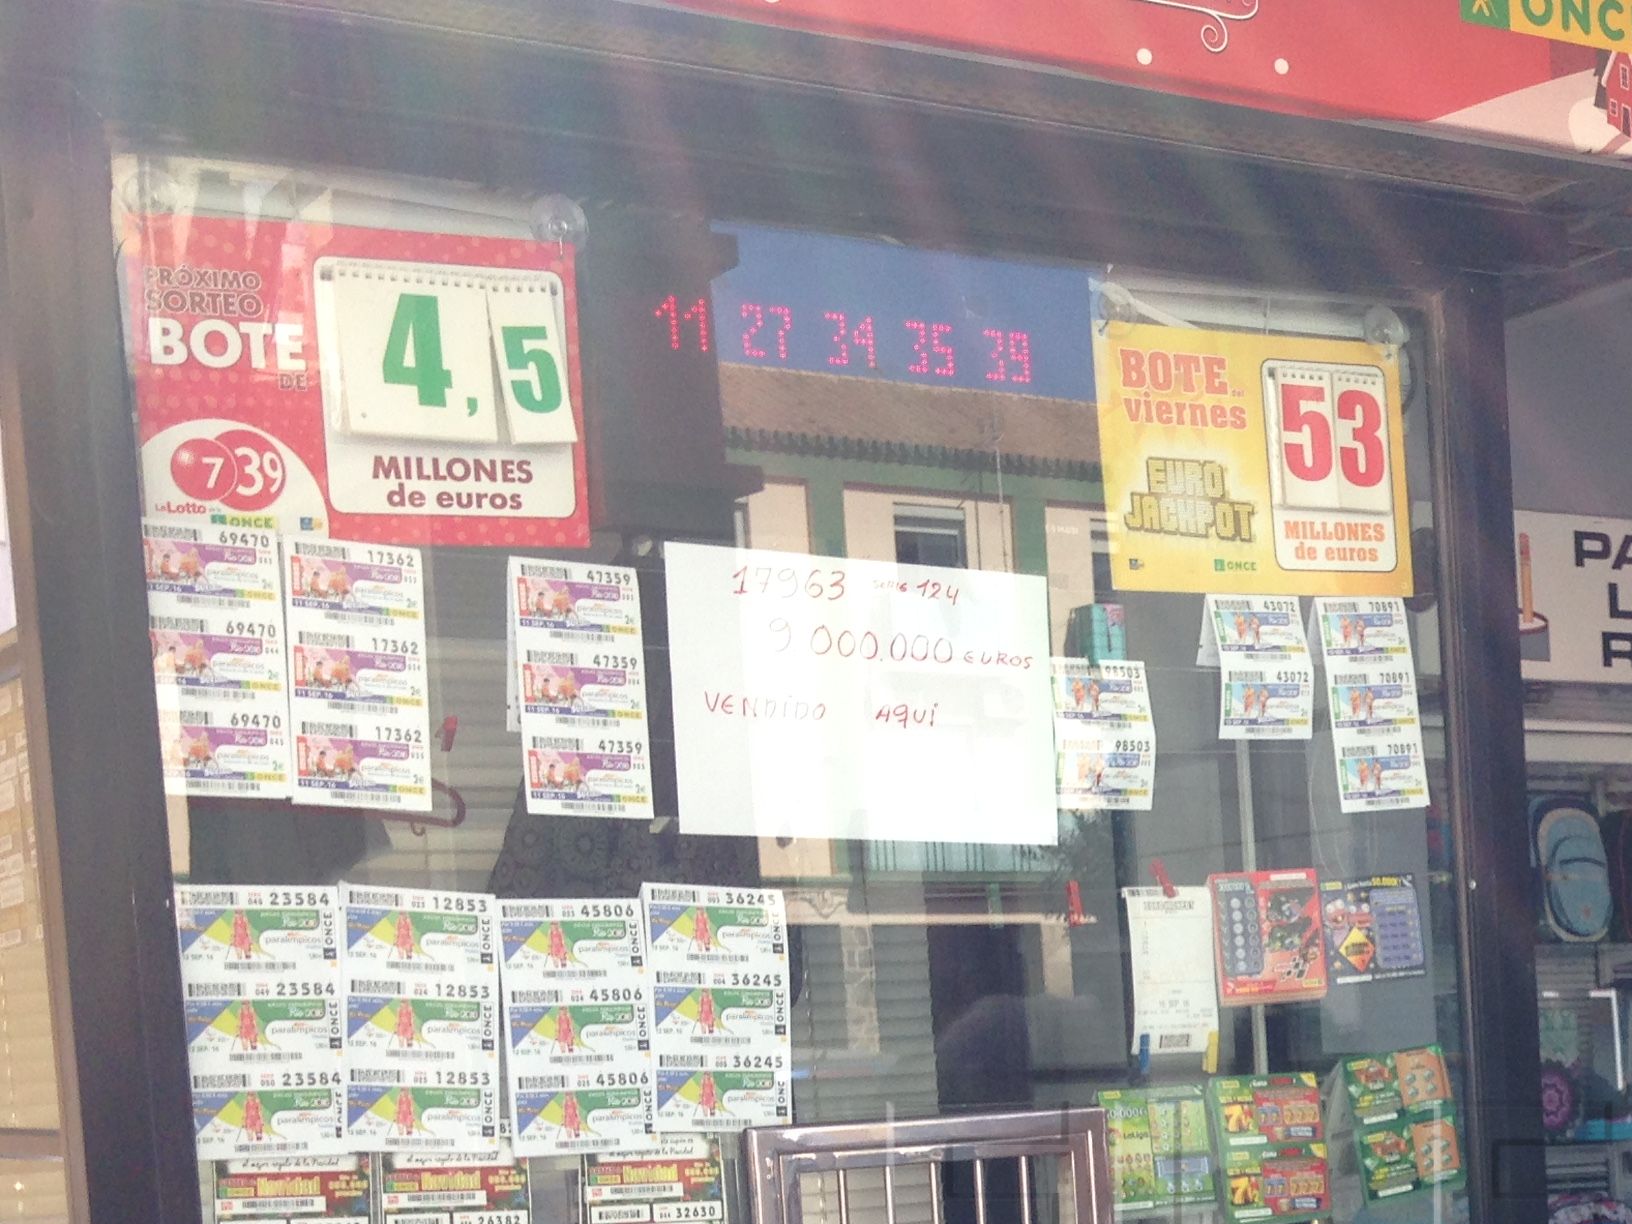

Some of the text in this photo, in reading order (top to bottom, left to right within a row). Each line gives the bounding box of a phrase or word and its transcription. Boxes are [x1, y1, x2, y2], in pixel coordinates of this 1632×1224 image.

[145, 289, 262, 317] SORTEO
[148, 318, 306, 370] BOTE
[655, 295, 1031, 383] 11 27 34 35 39
[1119, 347, 1229, 396] BOTE
[1122, 391, 1248, 430] viernes
[1280, 383, 1386, 488] 53
[372, 455, 532, 485] MILLONES
[1146, 457, 1228, 498] EURO
[387, 482, 522, 511] de euros
[227, 517, 273, 529] ONCE
[1124, 492, 1256, 542] JACKPOT
[219, 531, 269, 548] 69470
[1283, 520, 1386, 543] MILLONES
[368, 549, 414, 568] 17362
[1295, 542, 1379, 563] de euros
[1226, 560, 1257, 572] ONCE
[587, 570, 631, 585] 47359
[732, 565, 847, 601] 17963
[916, 579, 960, 606] 124
[226, 621, 276, 637] 69470
[372, 637, 418, 655] 17362
[593, 655, 638, 670] 47359
[231, 712, 281, 729] 69470
[376, 726, 422, 743] 17362
[598, 740, 642, 755] 47359
[1115, 740, 1151, 752] 98503
[269, 892, 330, 906] 23584
[432, 897, 487, 912] 12853
[580, 904, 634, 917] 45806
[323, 912, 333, 945] ONCE
[482, 918, 491, 950] ONCE
[773, 912, 783, 942] ONCE
[631, 923, 640, 954] ONCE
[276, 983, 335, 995] 23584
[731, 973, 782, 986] 36245
[435, 984, 490, 998] 12853
[589, 989, 642, 1001] 45806
[776, 993, 784, 1022] ONCE
[329, 1001, 338, 1035] ONCE
[484, 1006, 492, 1037] ONCE
[639, 1005, 647, 1038] ONCE
[733, 1056, 783, 1068] 36245
[282, 1072, 341, 1087] 23584
[435, 1072, 490, 1085] 12853
[596, 1072, 648, 1086] 45806
[485, 1092, 493, 1123] ONCE
[644, 1090, 652, 1121] ONCE
[676, 1206, 716, 1218] 32630
